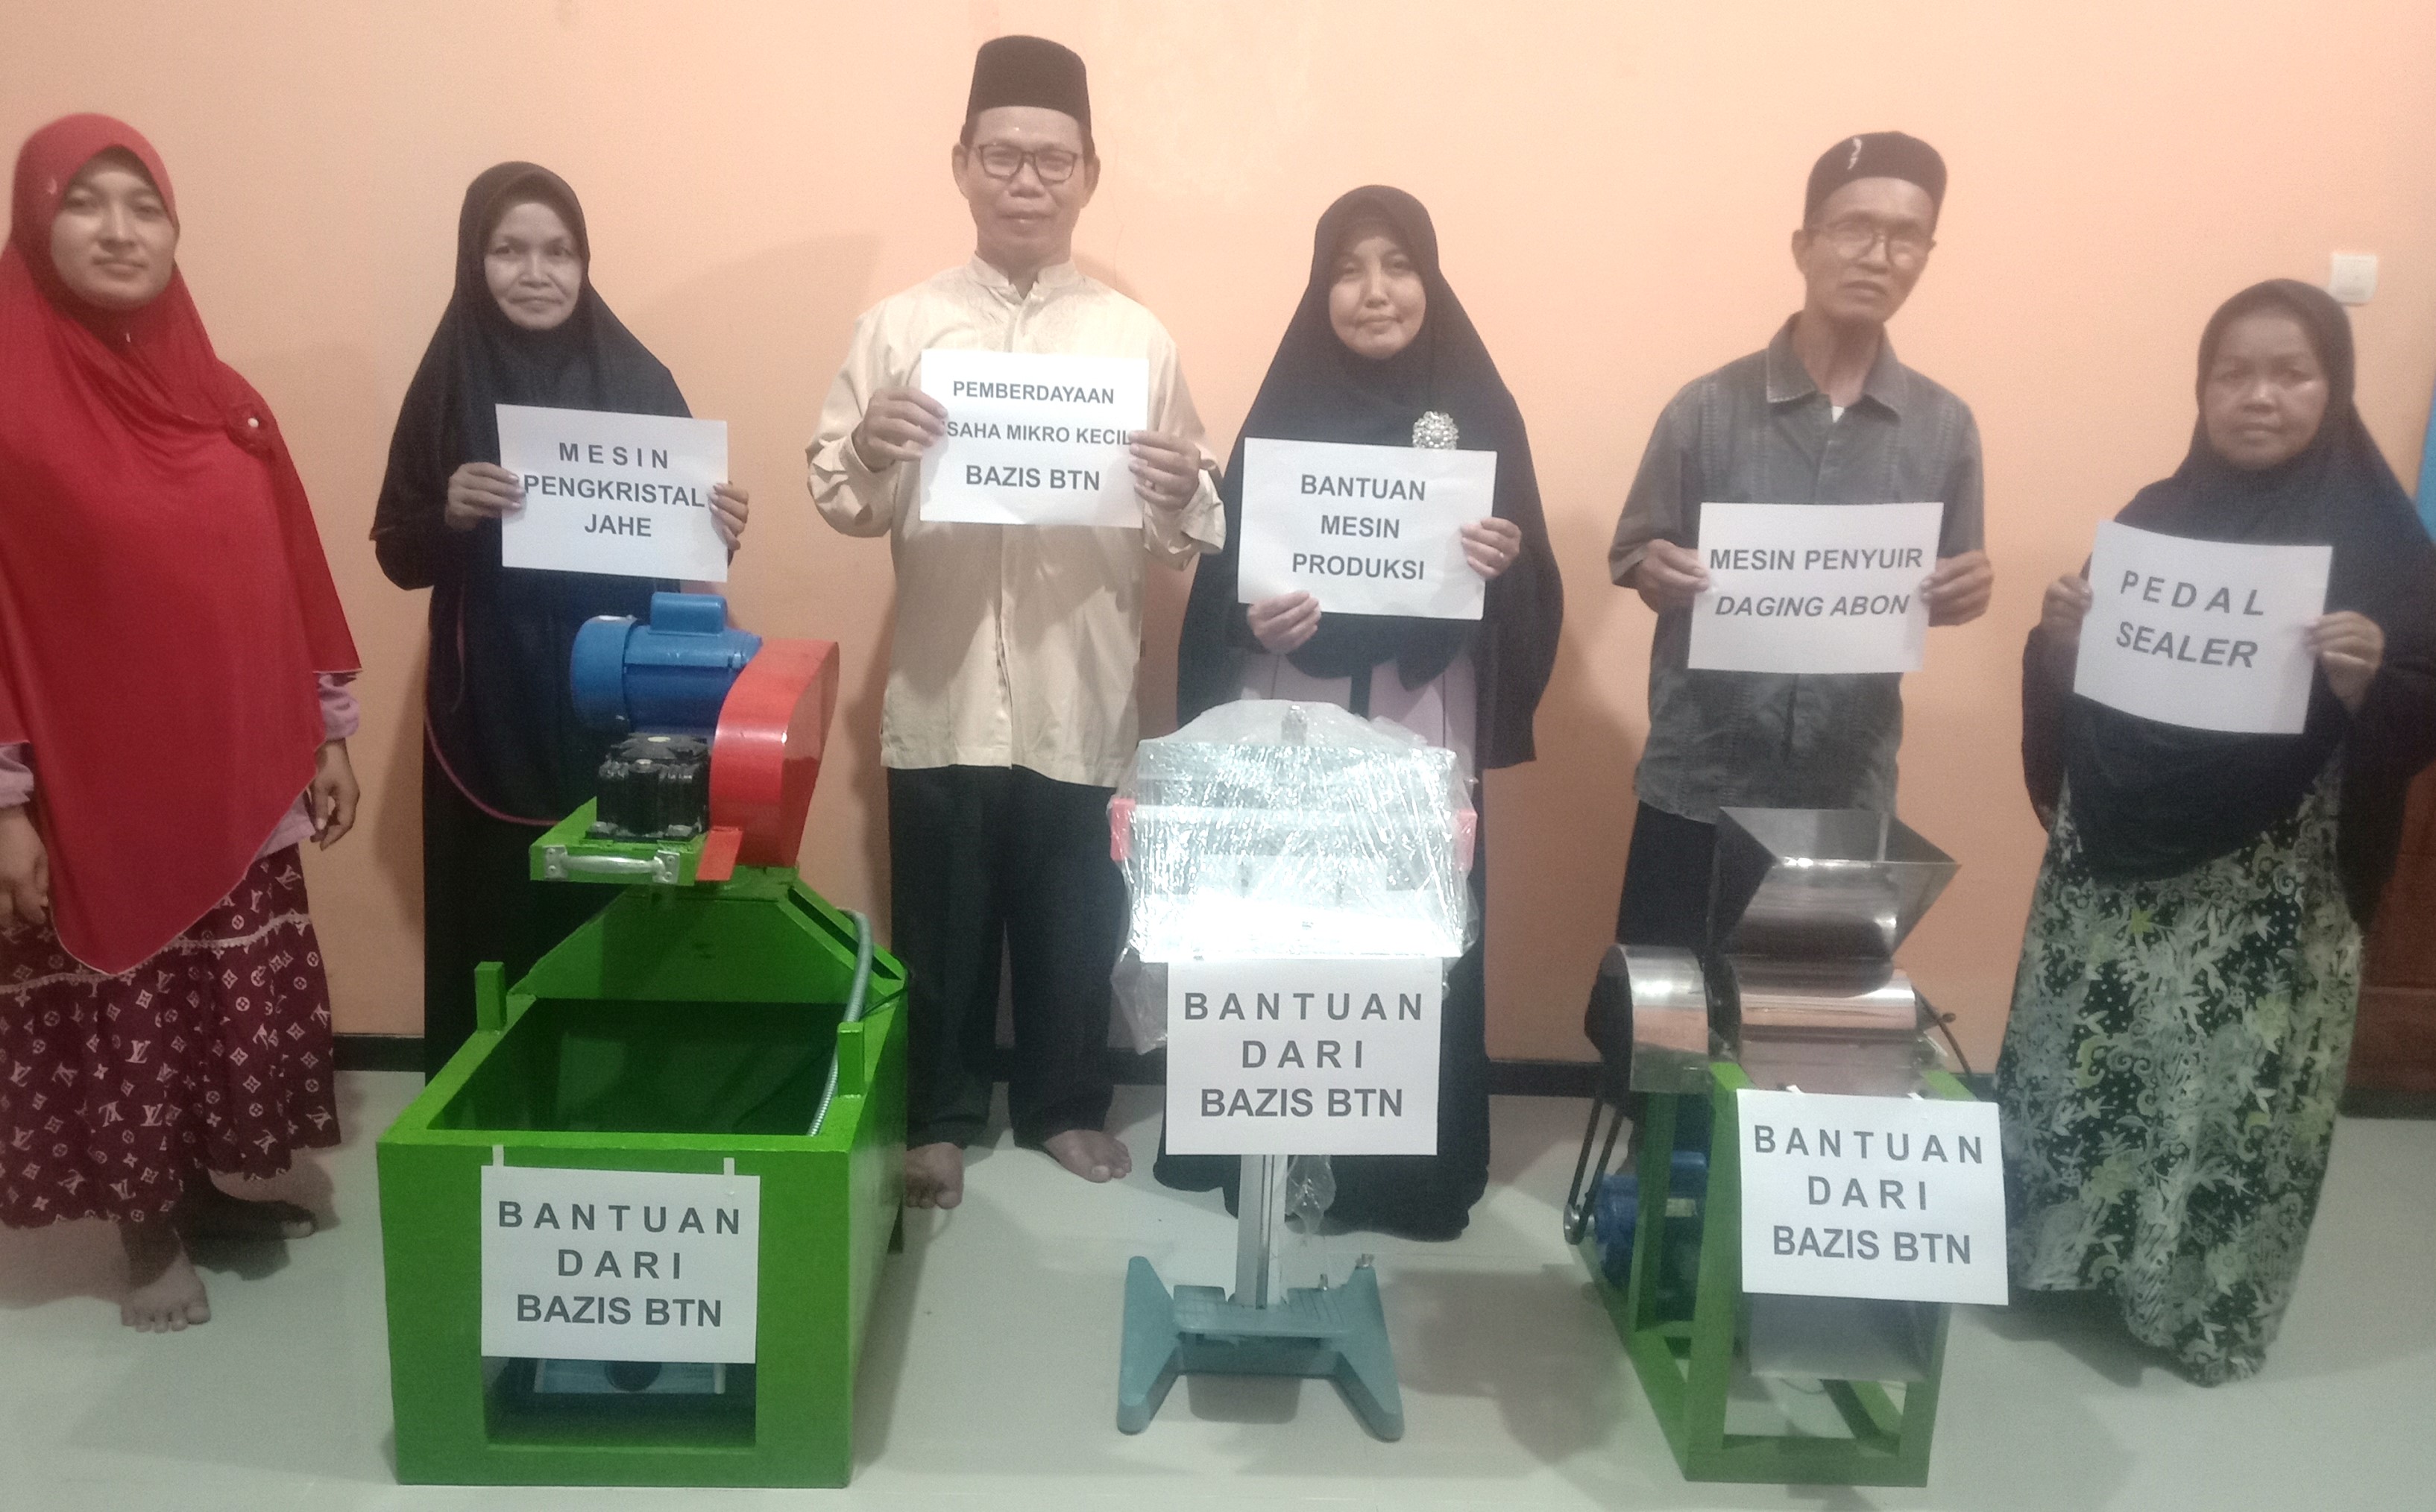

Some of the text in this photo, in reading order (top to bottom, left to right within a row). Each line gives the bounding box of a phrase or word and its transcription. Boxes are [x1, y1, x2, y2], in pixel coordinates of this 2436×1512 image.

[952, 379, 1115, 405] PEMBERDAYAAN
[942, 418, 1133, 447] SAHA MIKRO KECIL
[558, 441, 669, 470] MESIN
[523, 473, 706, 508] PENGKRISTAL
[965, 464, 1101, 492] BAZIS BTN
[1300, 473, 1426, 503] BANTUAN
[583, 512, 652, 538] JAHE
[1320, 513, 1401, 540] MESIN
[1291, 552, 1426, 581] PRODUKSI
[1709, 547, 1923, 571] MESIN PENYUIR
[1714, 593, 1910, 618] DAGING ABON
[2119, 569, 2265, 617] PEDAL
[2115, 620, 2259, 669] SEALER
[1183, 991, 1423, 1021] BANTUAN
[1241, 1039, 1364, 1069] DARI
[1200, 1087, 1403, 1118] BAZIS BTN
[1753, 1124, 1983, 1165] BANTUAN
[1807, 1174, 1927, 1212] DARI
[498, 1200, 740, 1235] BANTUAN
[1772, 1224, 1971, 1265] BAZIS BTN
[557, 1247, 682, 1280] DARI
[516, 1293, 723, 1329] BAZIS BTN
